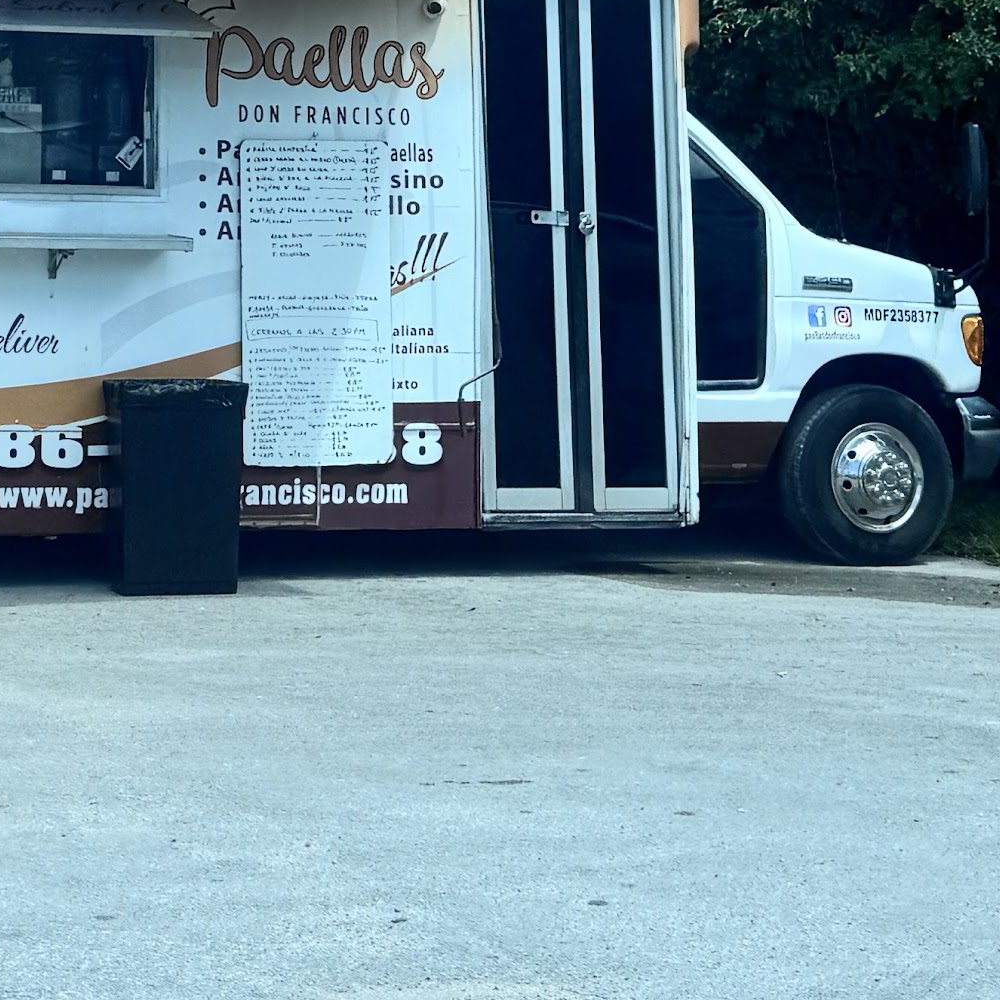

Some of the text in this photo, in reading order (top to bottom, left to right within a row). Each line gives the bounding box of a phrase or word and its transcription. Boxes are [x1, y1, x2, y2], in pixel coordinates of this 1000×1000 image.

[194, 25, 445, 107] Paellas
[239, 104, 410, 126] DON FRANCISCO
[390, 142, 433, 162] aellas
[390, 169, 444, 189] sino
[389, 195, 420, 215] llo
[864, 308, 939, 324] MDF2358377
[393, 325, 434, 337] aliana
[392, 378, 418, 390] ixto
